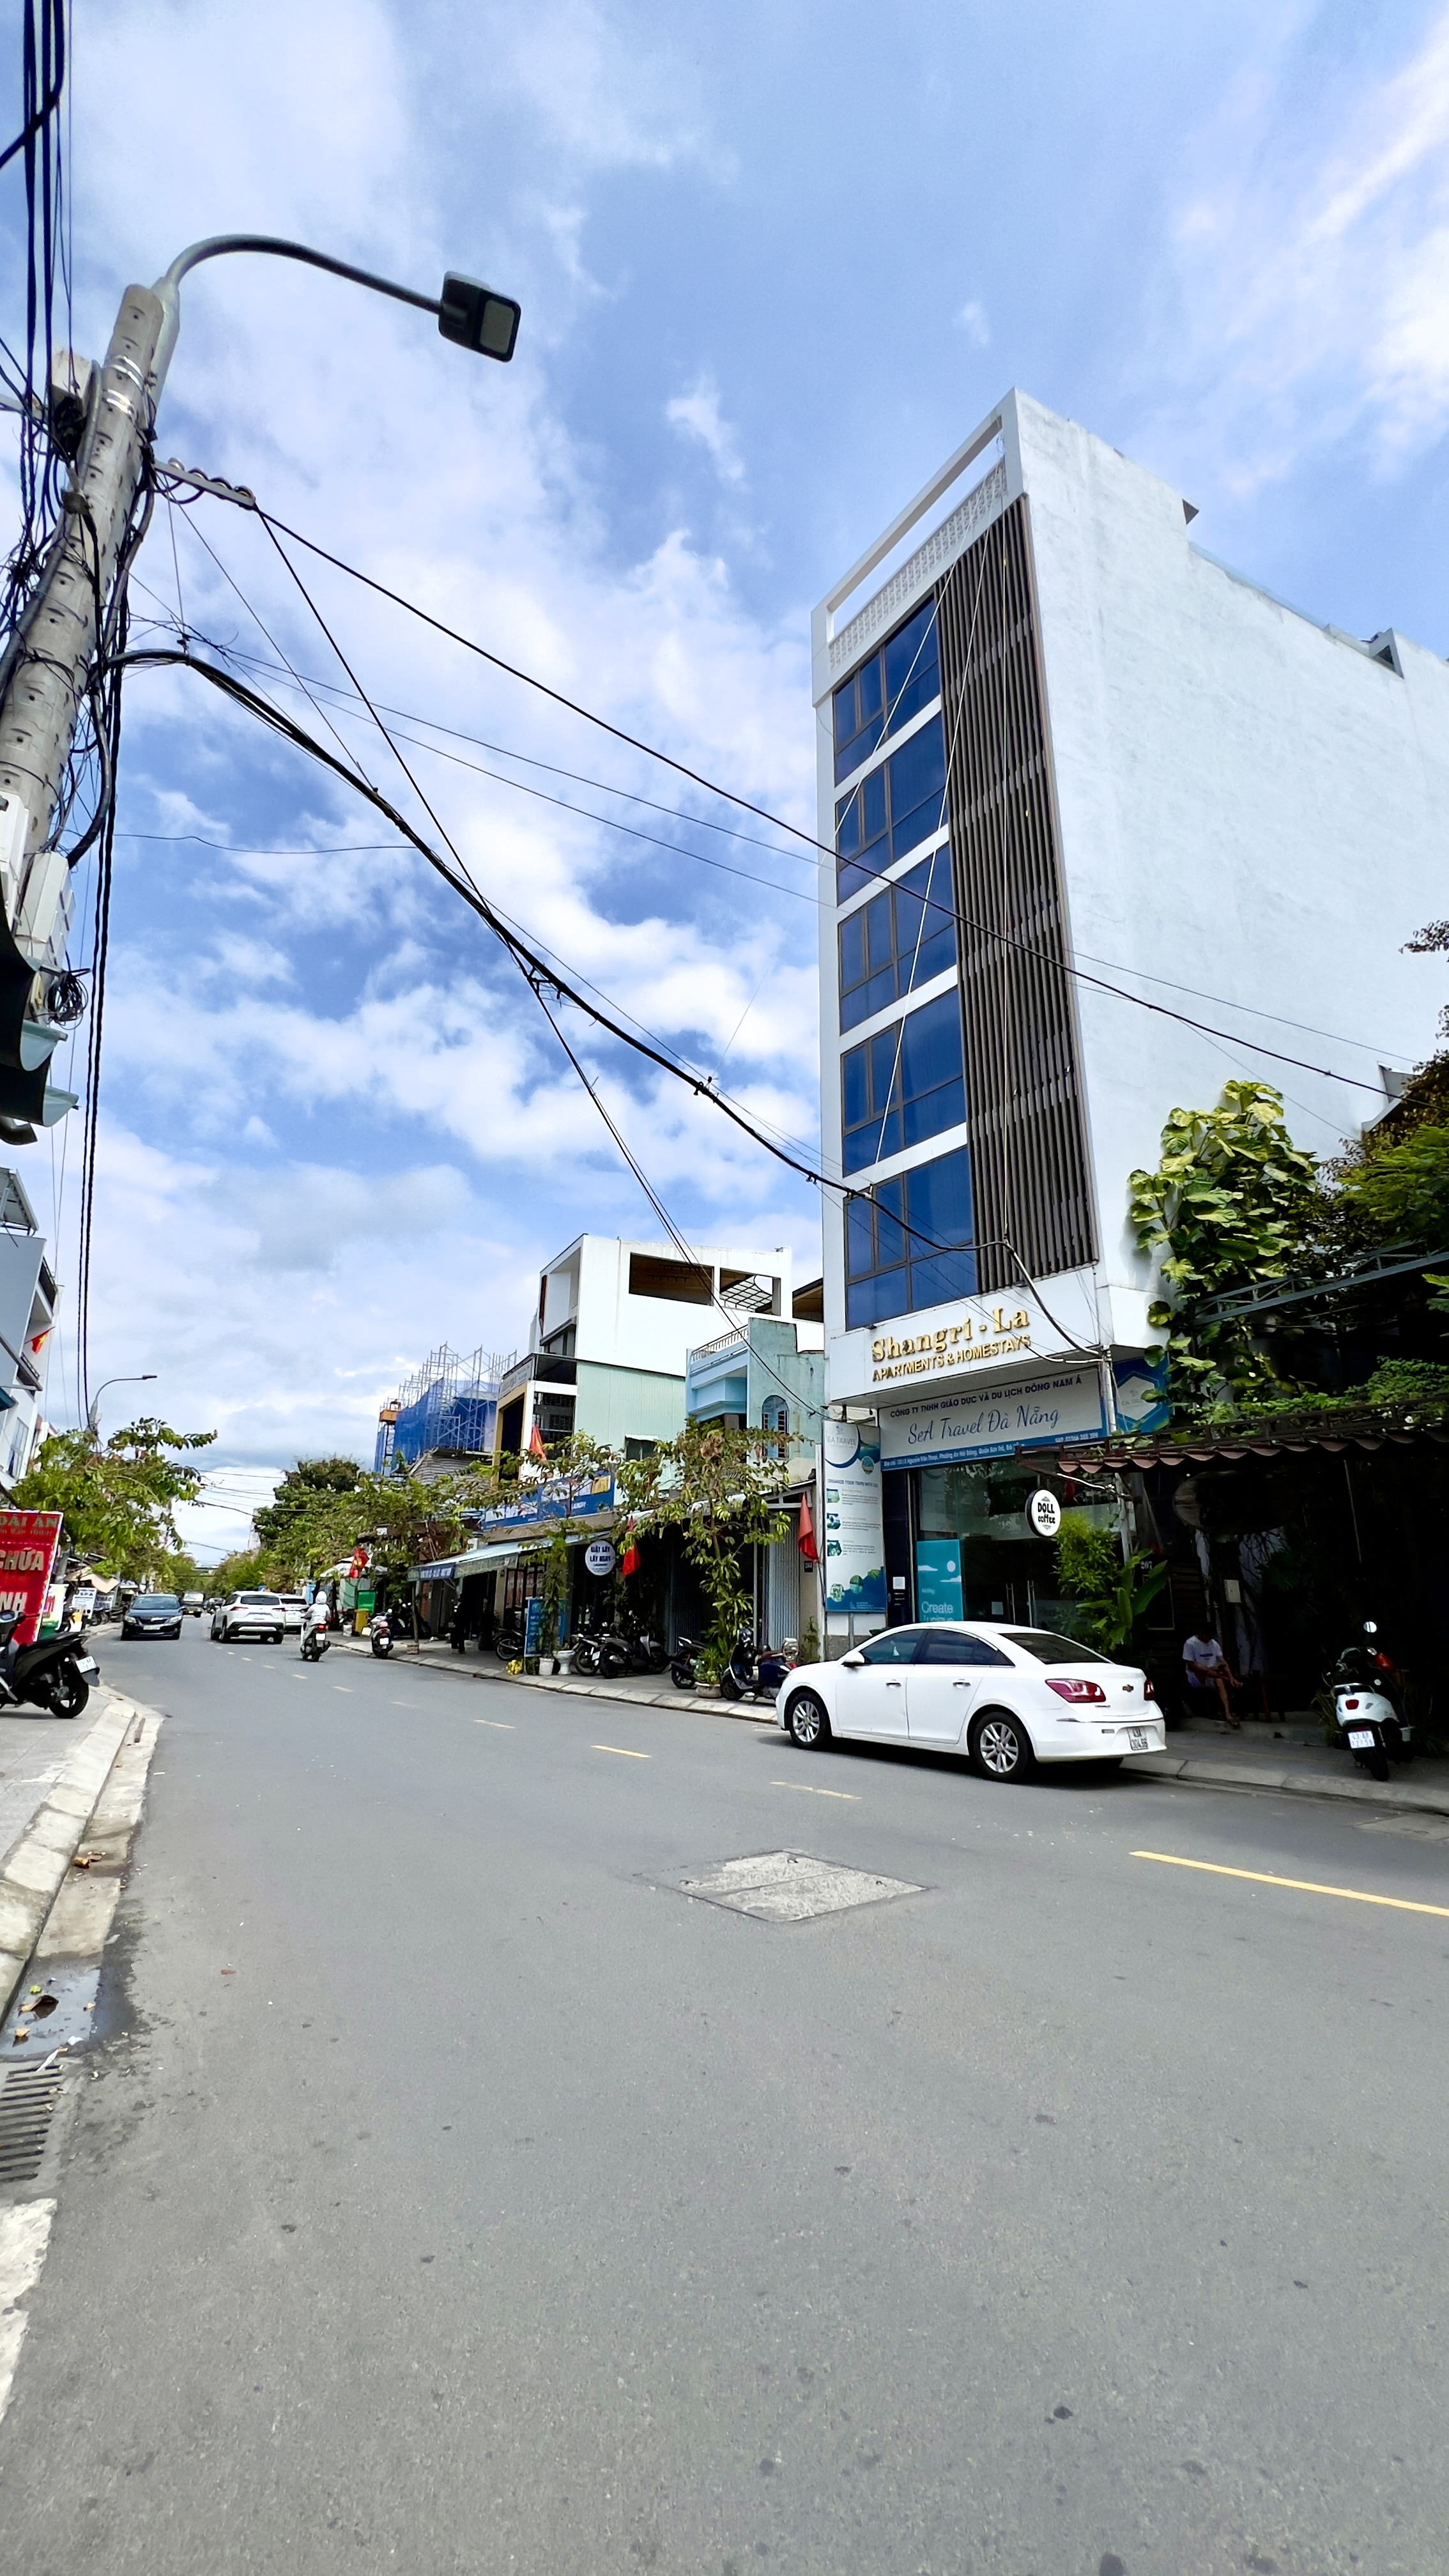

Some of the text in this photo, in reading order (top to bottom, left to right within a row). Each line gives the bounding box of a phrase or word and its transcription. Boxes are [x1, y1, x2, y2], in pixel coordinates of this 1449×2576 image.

[871, 1317, 972, 1363] Shangri
[993, 1308, 1030, 1333] La
[873, 1334, 1032, 1382] APARTMENTS & HOMESTAYS
[890, 1407, 910, 1418] CÔNG
[921, 1402, 939, 1413] TNHH
[940, 1398, 959, 1409] GIÁO
[979, 1392, 990, 1402] VÀ
[1004, 1388, 1022, 1399] LỊCH
[1025, 1383, 1050, 1393] ĐÔNG
[1053, 1377, 1073, 1388] NAM
[1076, 1374, 1082, 1384] Á
[940, 1411, 984, 1439] Travel
[988, 1409, 1011, 1432] Đà
[1016, 1404, 1059, 1429] Nẵng
[1038, 1502, 1055, 1514] DOLL
[1038, 1514, 1055, 1524] coffee
[921, 1601, 953, 1614] Create
